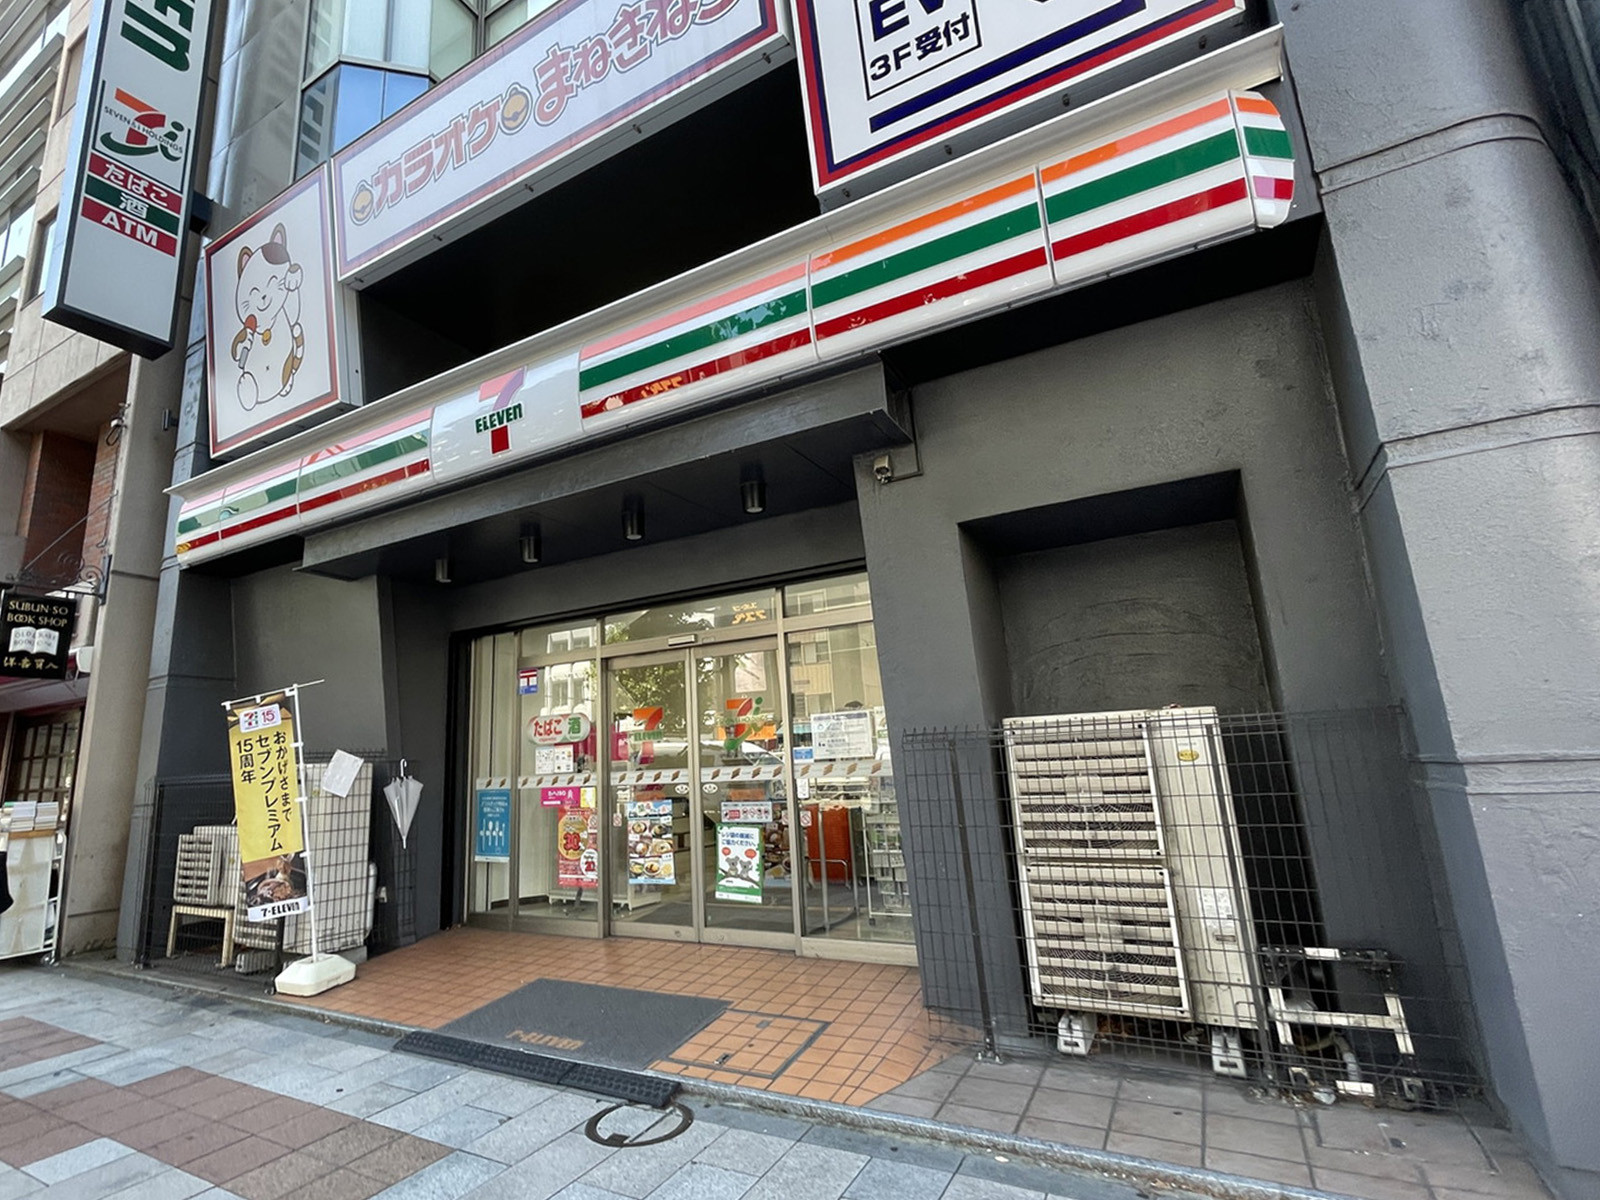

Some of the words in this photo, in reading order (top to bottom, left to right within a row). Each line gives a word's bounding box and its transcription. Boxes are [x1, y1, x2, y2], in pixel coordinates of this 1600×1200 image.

[869, 11, 971, 82] 3F受付
[104, 106, 132, 129] SEVEN
[142, 125, 184, 153] HOLDINGS
[371, 95, 503, 219] カラオケ
[104, 163, 168, 207] たばこ
[119, 191, 149, 219] 酒
[102, 211, 158, 247] ATM
[7, 613, 35, 624] BOOK
[38, 616, 67, 627] SHOP
[52, 606, 68, 615] SO
[261, 709, 275, 723] 15
[533, 718, 563, 737] たばこ
[567, 716, 582, 735] 酒
[236, 737, 257, 785] 15周年
[273, 730, 293, 823] おかげさまで
[255, 734, 284, 852] セブンプレミアム
